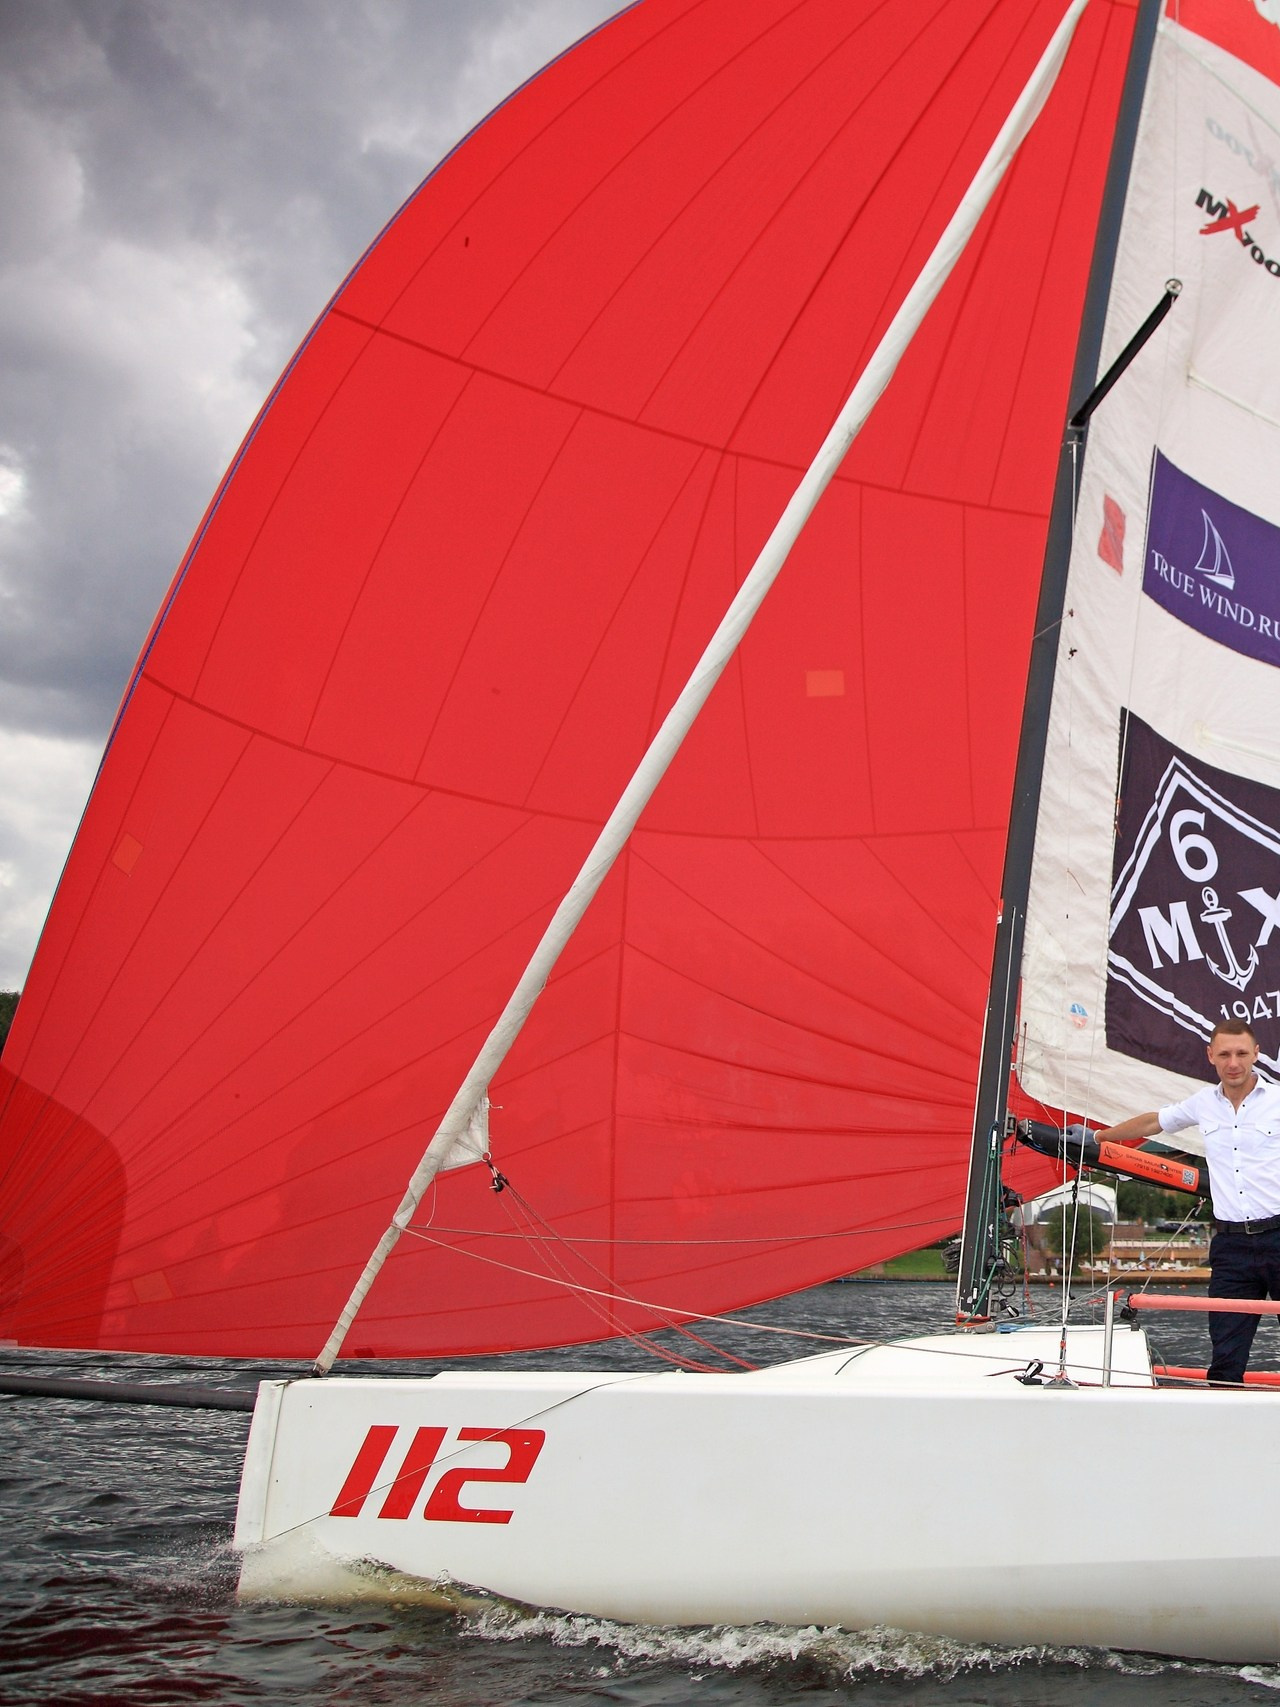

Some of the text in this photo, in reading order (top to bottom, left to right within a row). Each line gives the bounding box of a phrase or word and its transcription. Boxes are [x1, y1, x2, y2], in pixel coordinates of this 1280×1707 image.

[1151, 549, 1195, 598] TRUE
[1169, 809, 1219, 883] 6
[328, 1425, 546, 1525] 112
